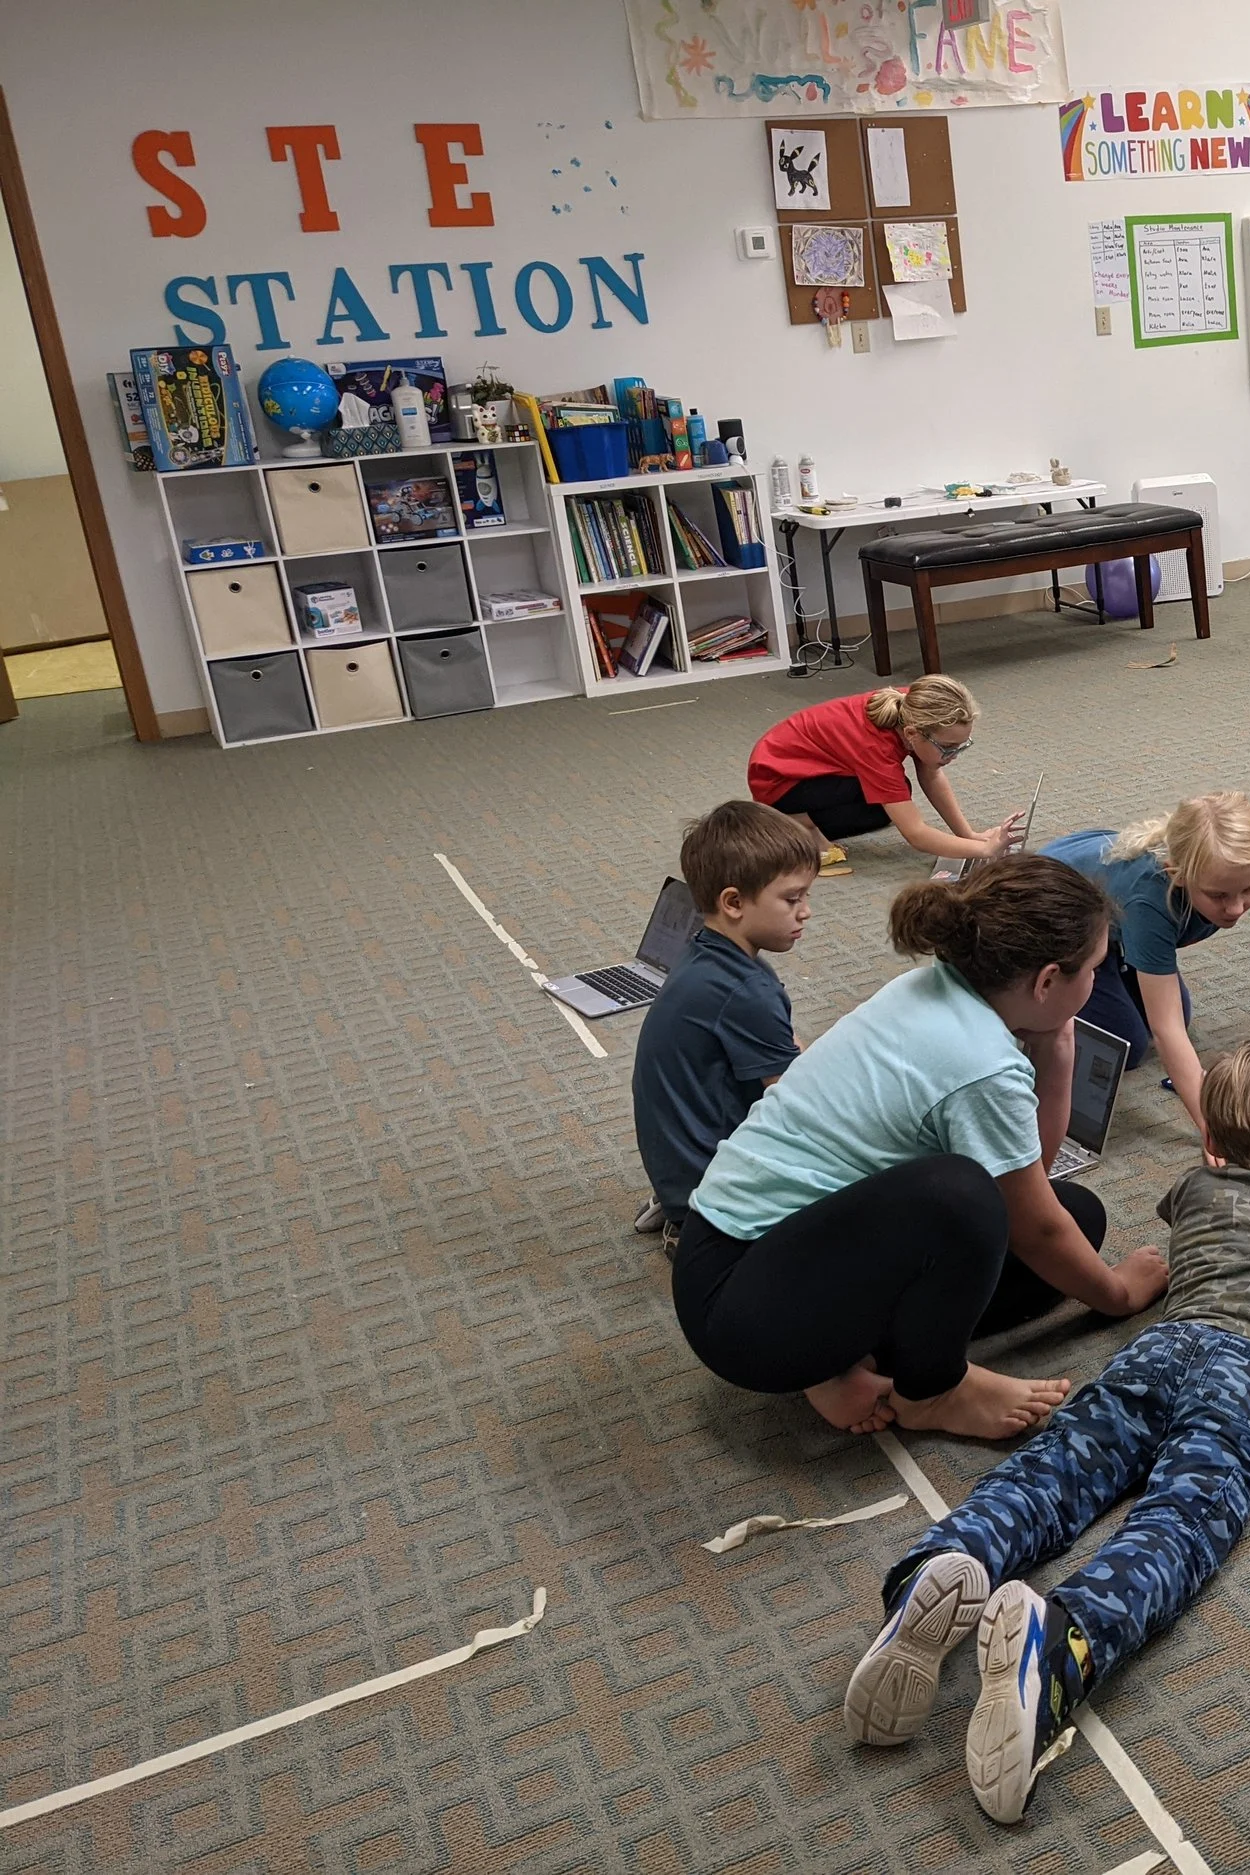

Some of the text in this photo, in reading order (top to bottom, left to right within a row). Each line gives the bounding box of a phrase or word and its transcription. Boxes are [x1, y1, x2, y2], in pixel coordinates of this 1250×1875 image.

[908, 0, 1036, 76] FAME
[1100, 89, 1234, 133] LEARN
[1085, 136, 1250, 176] SOMETHING NEW
[164, 252, 649, 351] STATION
[157, 354, 170, 376] DIY
[186, 366, 214, 448] INVENTIONS
[199, 374, 221, 439] RIDICULOUS
[620, 521, 637, 567] SCIENCE
